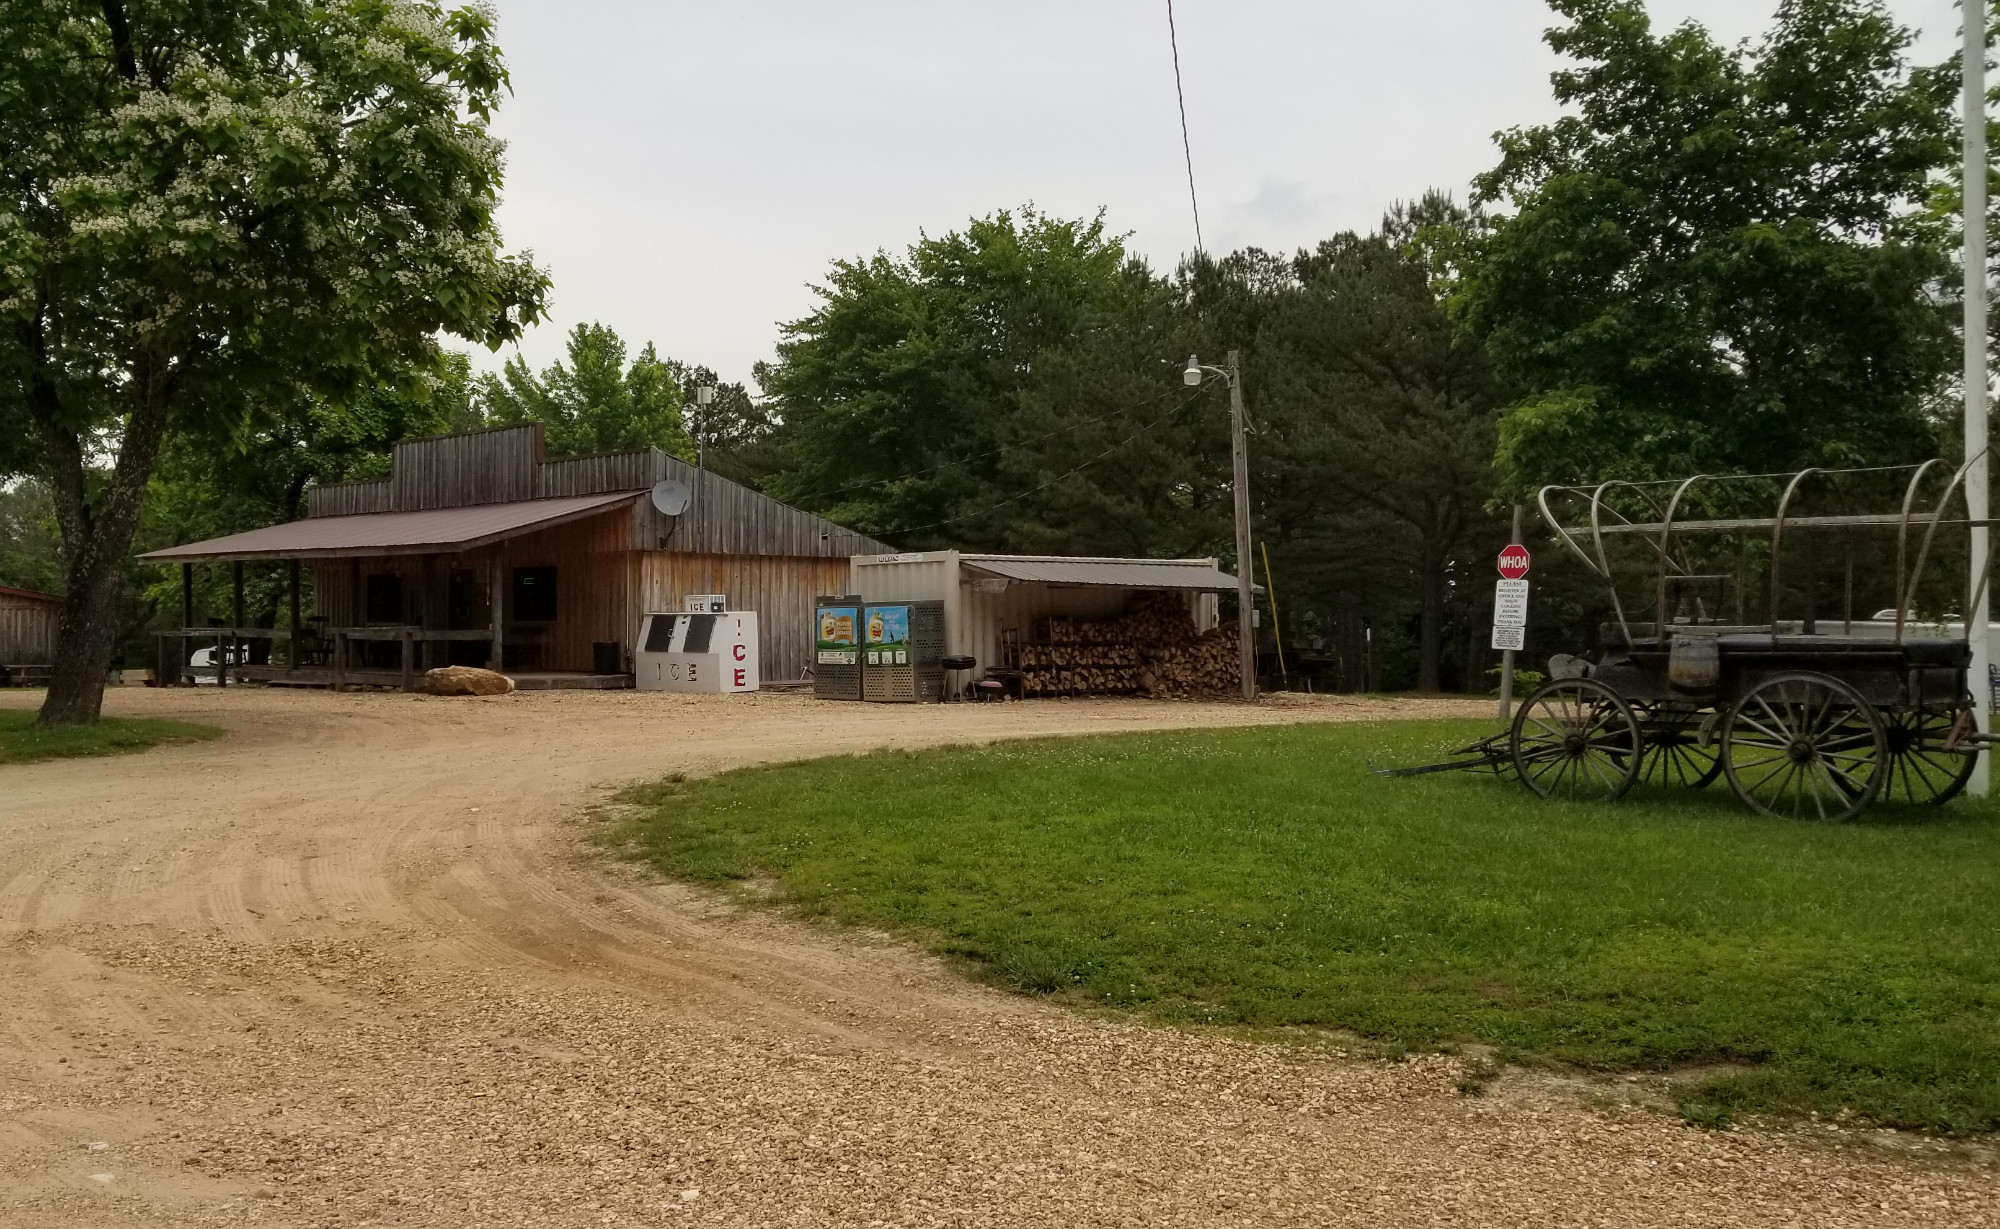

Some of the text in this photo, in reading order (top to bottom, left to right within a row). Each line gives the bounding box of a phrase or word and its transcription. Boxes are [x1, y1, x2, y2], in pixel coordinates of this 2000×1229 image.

[1500, 556, 1527, 568] WHOA
[690, 603, 704, 611] ICE
[732, 618, 746, 687] ICE
[656, 662, 697, 682] ICE
